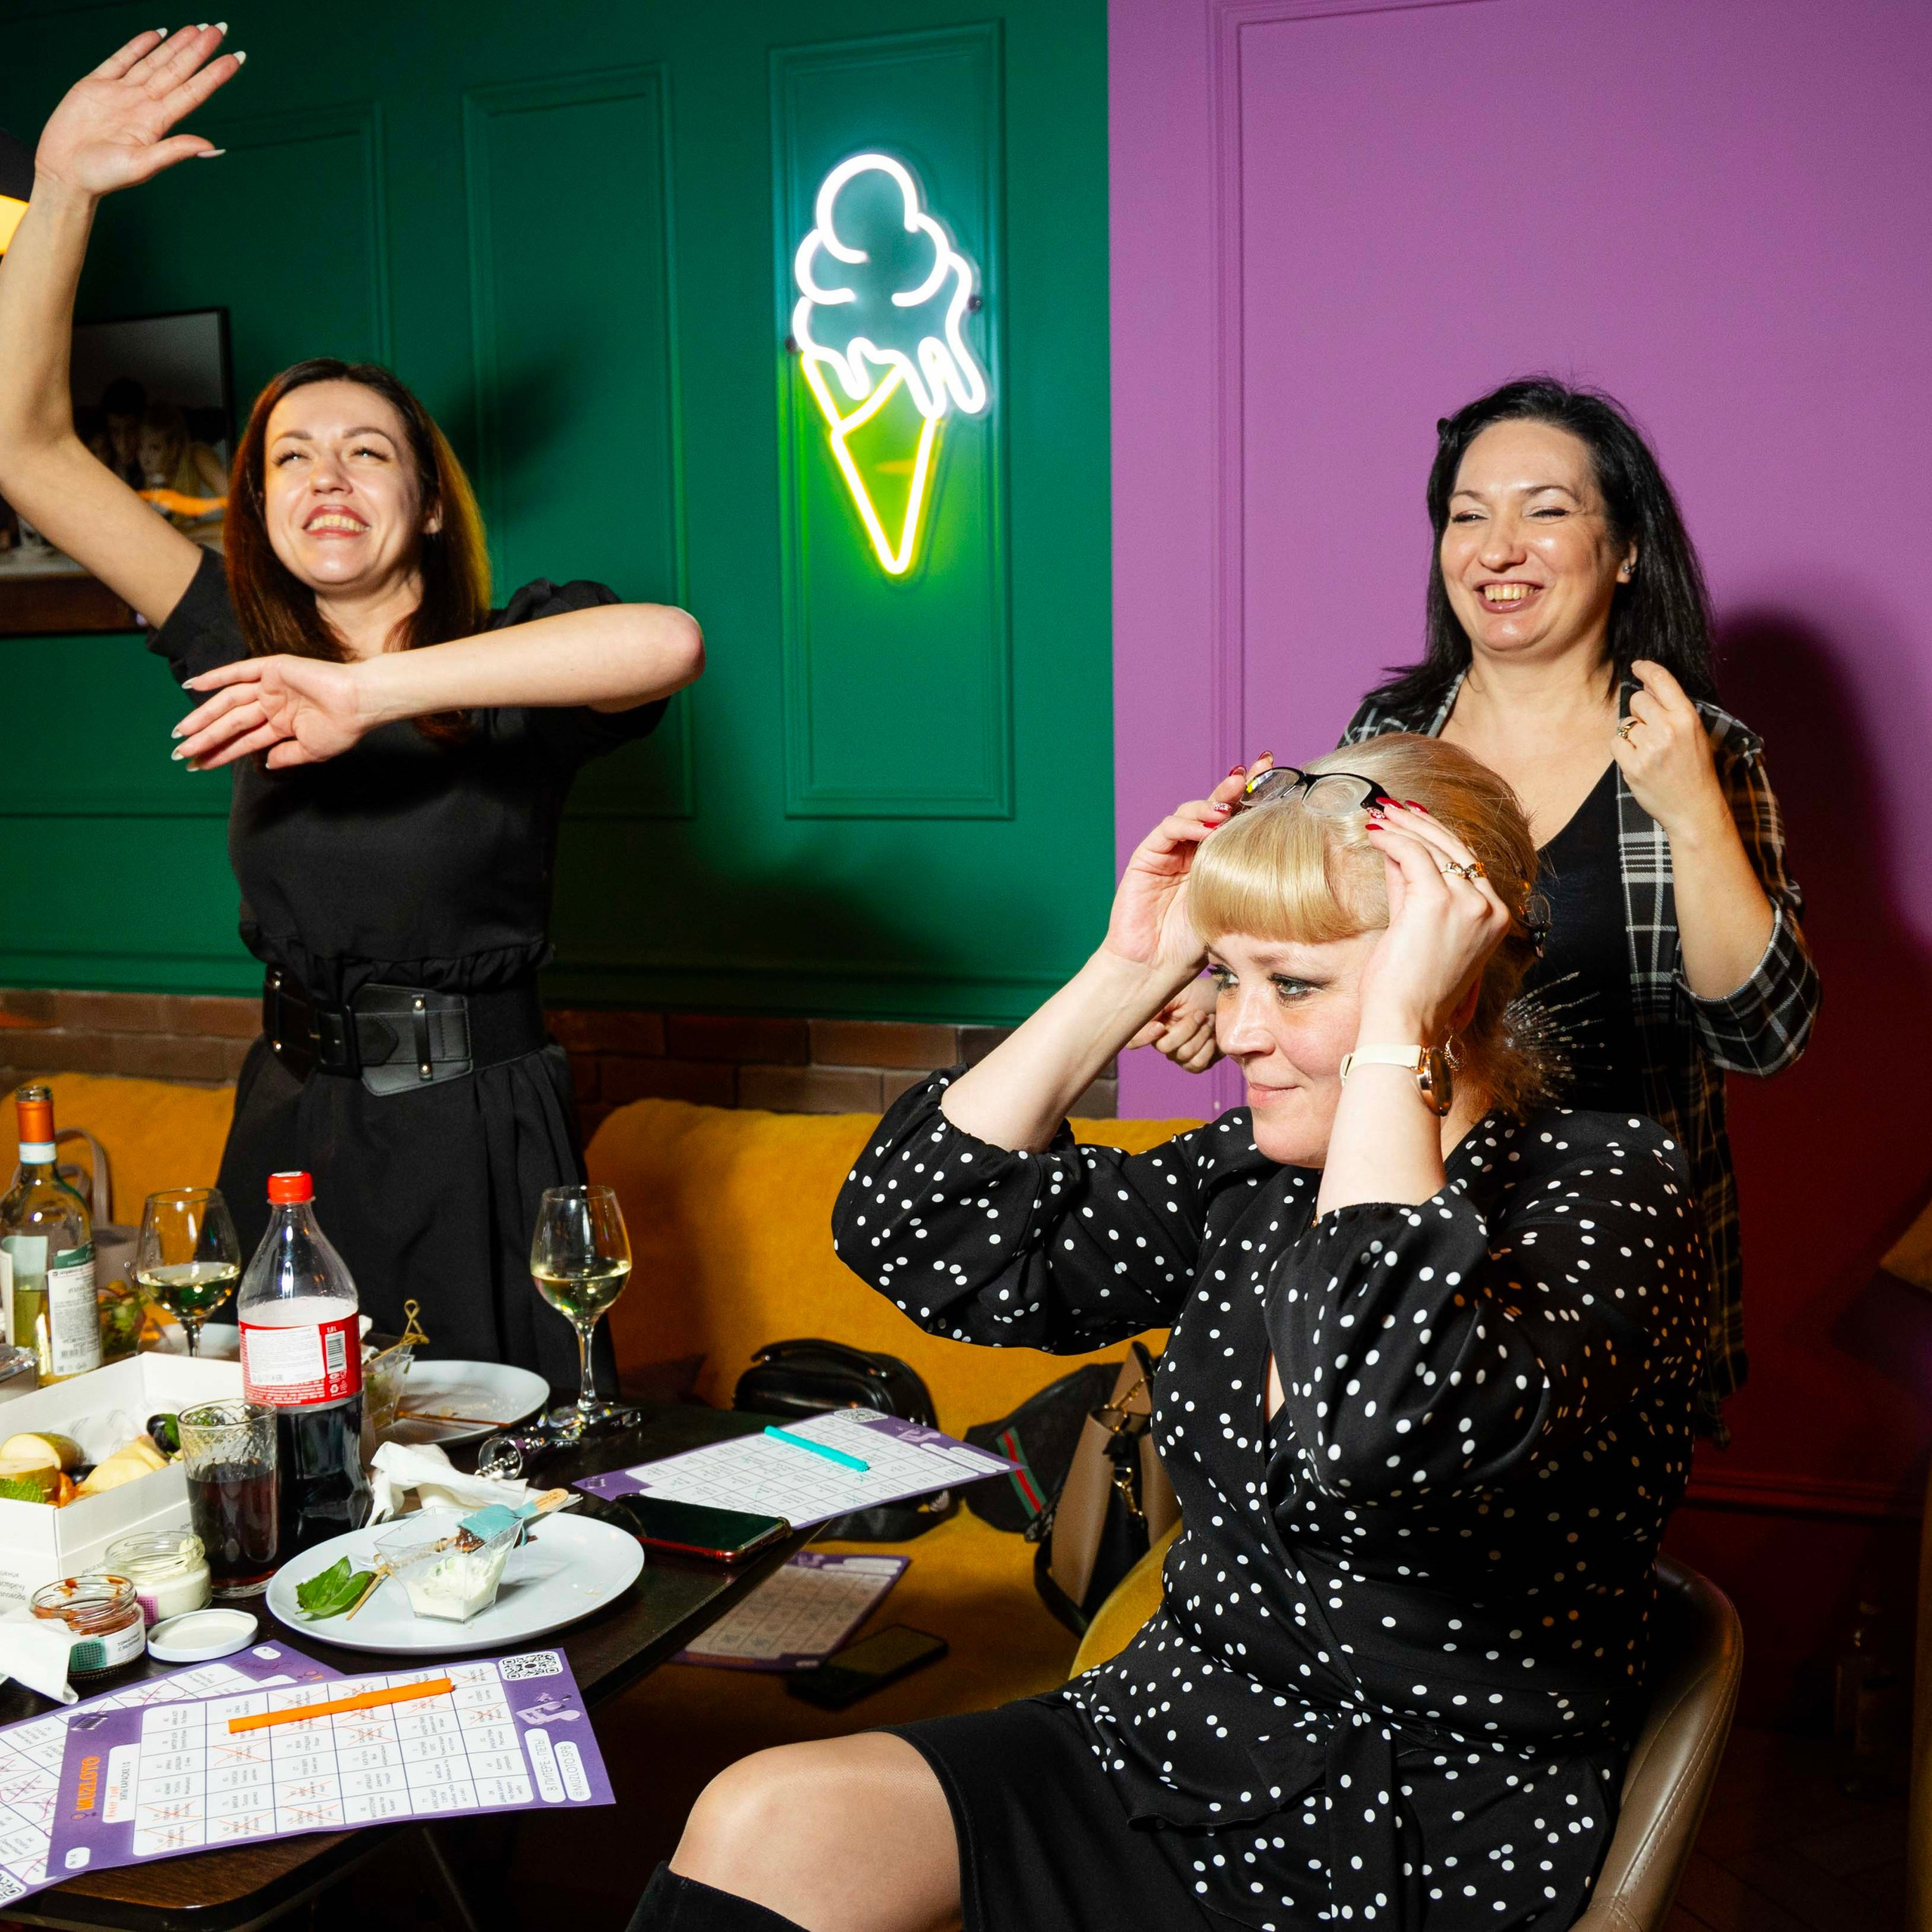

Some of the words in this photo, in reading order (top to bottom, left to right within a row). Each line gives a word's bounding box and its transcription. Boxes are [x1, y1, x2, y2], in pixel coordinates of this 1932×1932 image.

[531, 1737, 548, 1757] ПЕТЬ!
[75, 1755, 100, 1810] MUZLOTO
[119, 1767, 130, 1789] КАРАОКЕ
[538, 1759, 557, 1786] ПИТЕРЕ
[559, 1744, 586, 1797] @MUZLOTO.SPB
